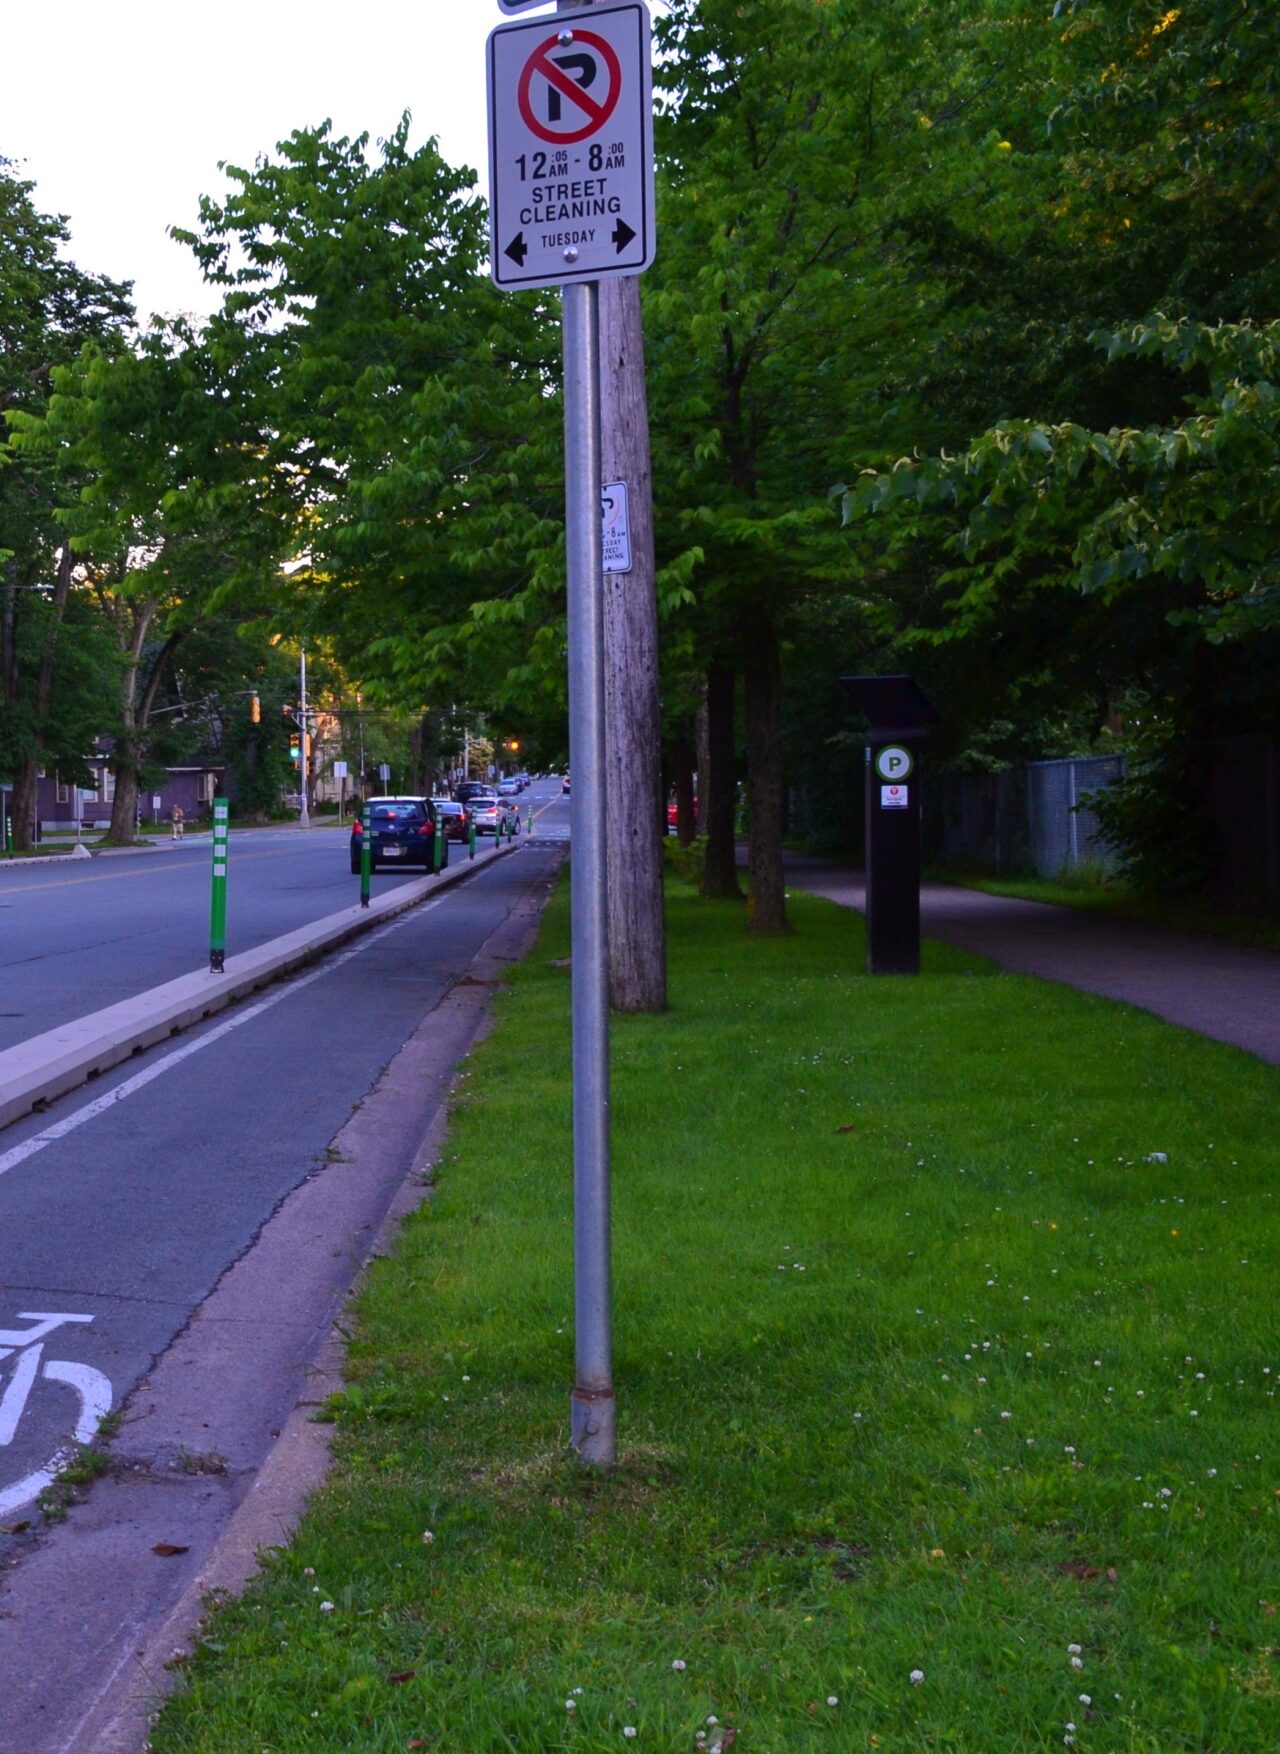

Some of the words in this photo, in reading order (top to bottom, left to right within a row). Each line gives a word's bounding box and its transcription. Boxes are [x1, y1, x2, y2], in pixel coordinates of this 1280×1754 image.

[547, 53, 597, 122] P
[532, 178, 607, 204] STREET
[519, 196, 621, 225] CLEANING
[541, 229, 595, 248] TUESDAY
[603, 552, 624, 560] ANING
[889, 756, 902, 771] P
